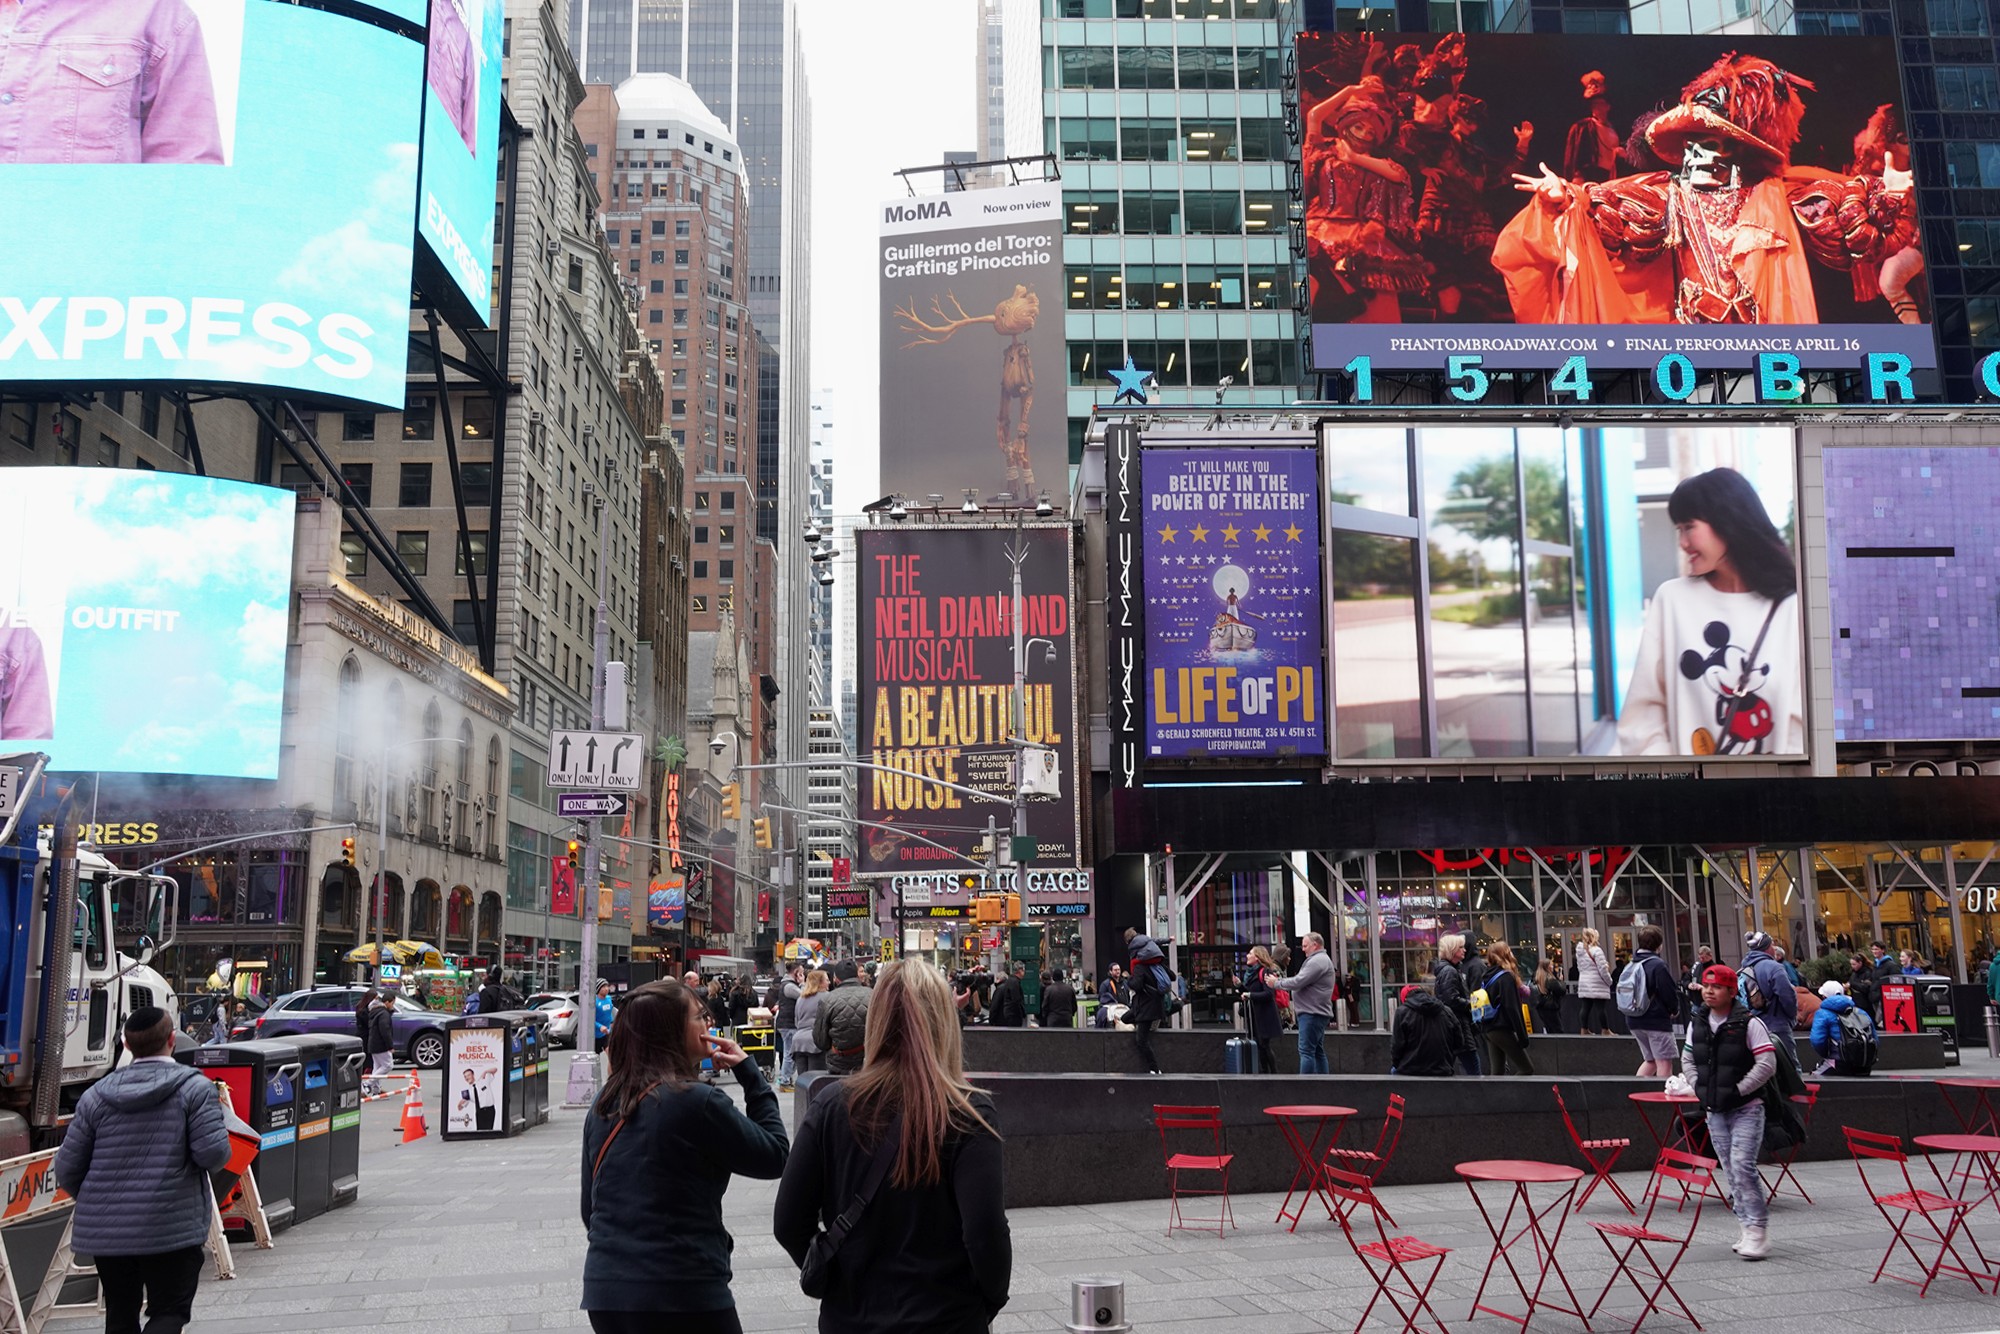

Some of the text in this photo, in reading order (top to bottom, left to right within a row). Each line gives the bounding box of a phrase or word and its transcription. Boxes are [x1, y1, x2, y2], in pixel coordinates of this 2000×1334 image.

[885, 201, 952, 223] MoMA
[984, 204, 1008, 214] Now
[1026, 200, 1051, 210] view
[427, 191, 486, 300] EXPRESS
[885, 235, 1052, 261] Guillermo del Toro:
[884, 251, 1050, 278] Crafting Pinocchio
[0, 296, 374, 379] XPRESS
[1391, 338, 1860, 351] PHANTOMBROADWAY.COM FINAL PERFORMANCE APRIL 16
[1200, 462, 1220, 473] WILL
[1224, 462, 1248, 473] MAKE
[1252, 461, 1270, 473] YOU
[1169, 474, 1288, 492] BELIEVE IN THE
[1152, 494, 1204, 511] POWER
[1208, 494, 1227, 510] OF
[876, 555, 920, 596] THE
[72, 606, 180, 632] OUTFIT
[876, 595, 1067, 638] NEIL DIAMOND
[402, 612, 434, 648] MILLER
[439, 637, 474, 673] BUILDING
[876, 639, 982, 682] MUSICAL
[1154, 666, 1314, 724] LIFE OF PI
[872, 684, 1062, 746] A BEAUTIUL
[1166, 728, 1316, 739] GERALD SCHOENFELD THEATRE, 236 W. 45TH ST.
[1208, 740, 1266, 750] LIFEOFPIBWAY.COM
[552, 774, 572, 783] ONLY
[578, 774, 599, 784] ONLY
[608, 776, 634, 785] ONLY
[872, 748, 962, 811] NOISE
[968, 772, 1007, 780] "SWEET
[568, 800, 616, 810] ONE WAY
[667, 774, 683, 868] HAVANA
[38, 822, 158, 845] PRESS
[901, 846, 959, 861] ON BROADWAY
[1036, 844, 1064, 852] ODAY!
[829, 893, 868, 906] ELECTRONICS
[930, 908, 960, 916] Nikon
[1056, 905, 1087, 914] BOWER
[458, 1052, 496, 1060] MUSICAL
